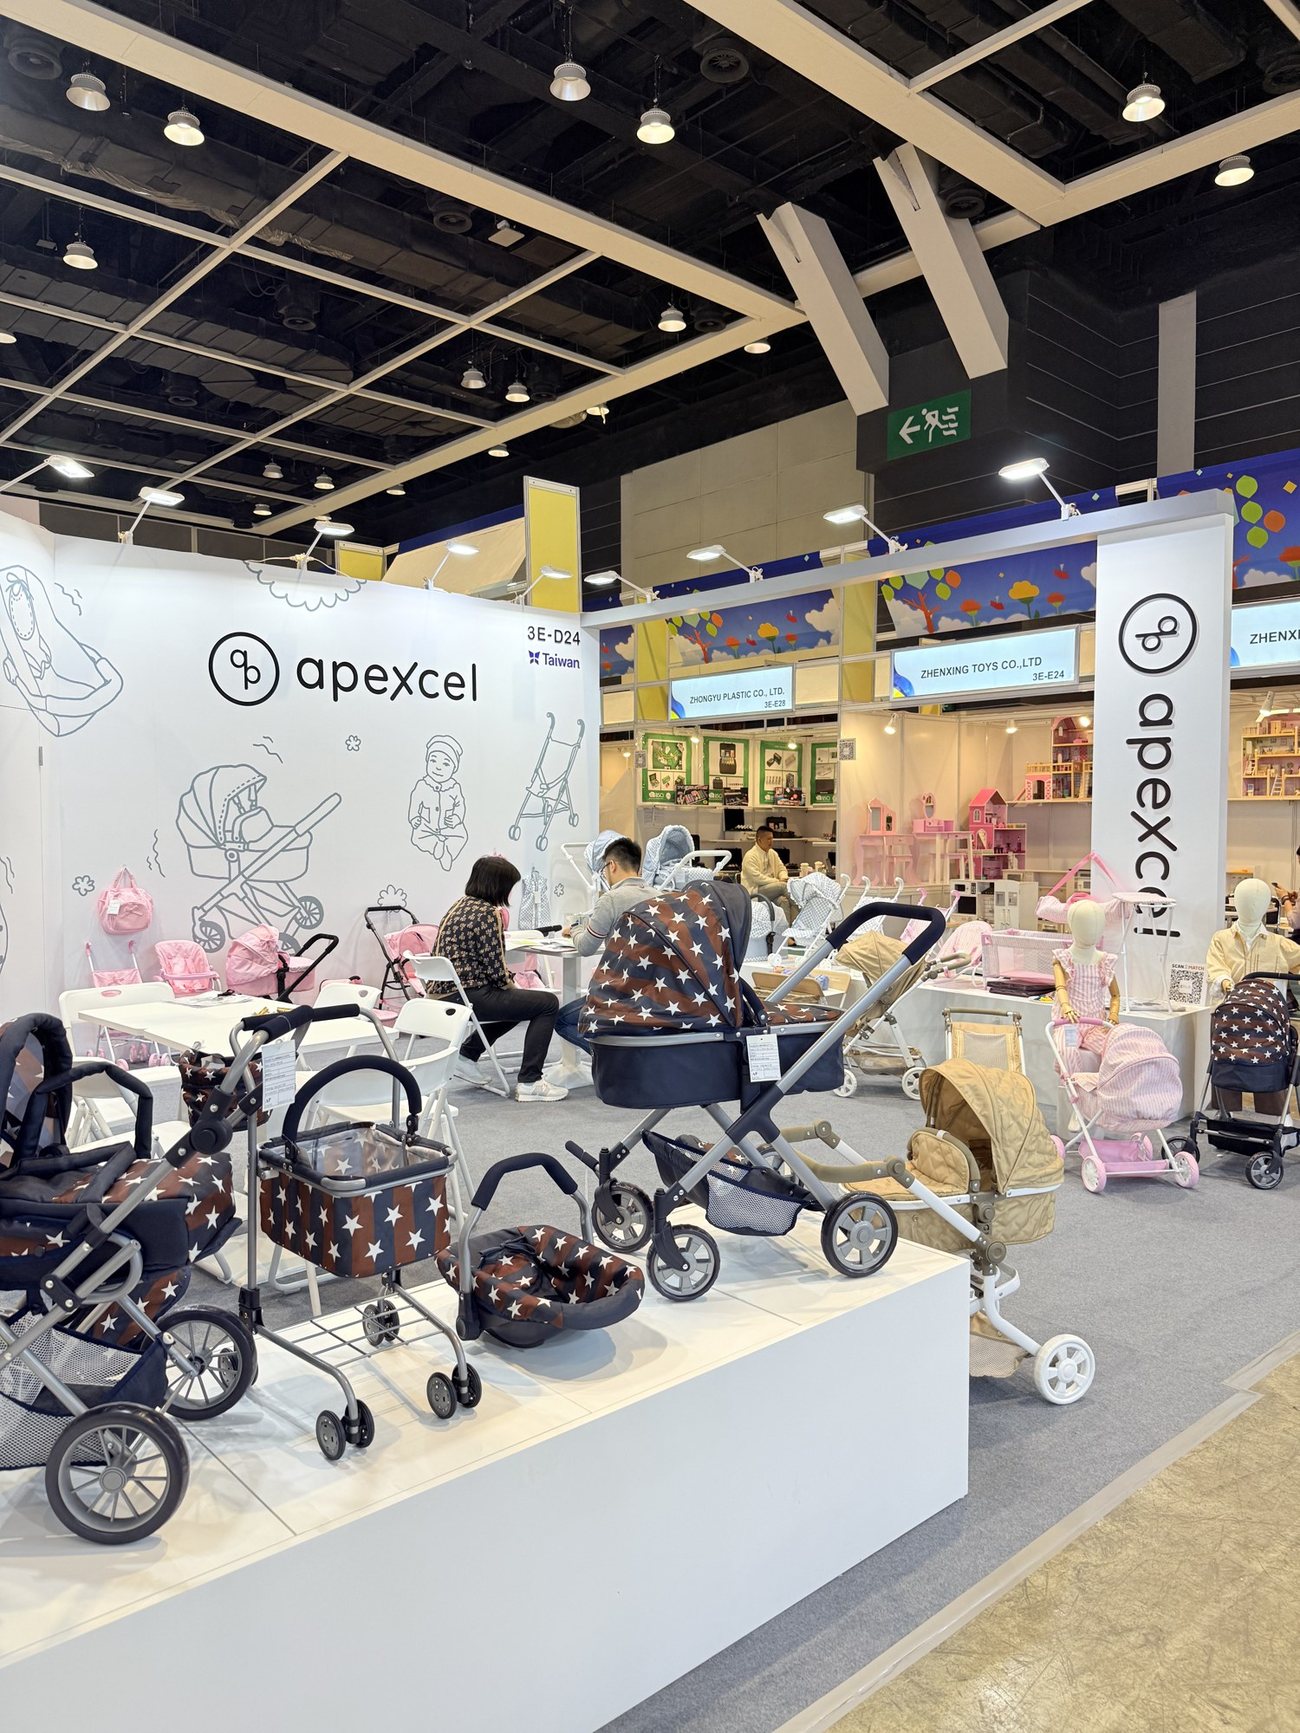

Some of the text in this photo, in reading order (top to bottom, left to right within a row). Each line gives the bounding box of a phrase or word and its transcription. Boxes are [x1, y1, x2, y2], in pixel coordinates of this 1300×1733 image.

[527, 625, 581, 646] 3E-D24
[542, 652, 580, 669] Taiwan
[920, 665, 969, 679] ZHENXING
[972, 661, 998, 673] TOYS
[1032, 670, 1065, 681] 3E-E24
[297, 657, 477, 702] apexcel
[689, 694, 722, 704] ZHONGYU
[723, 690, 752, 701] PLASTIC
[769, 687, 785, 696] LTD.
[764, 700, 786, 708] 3E-E28
